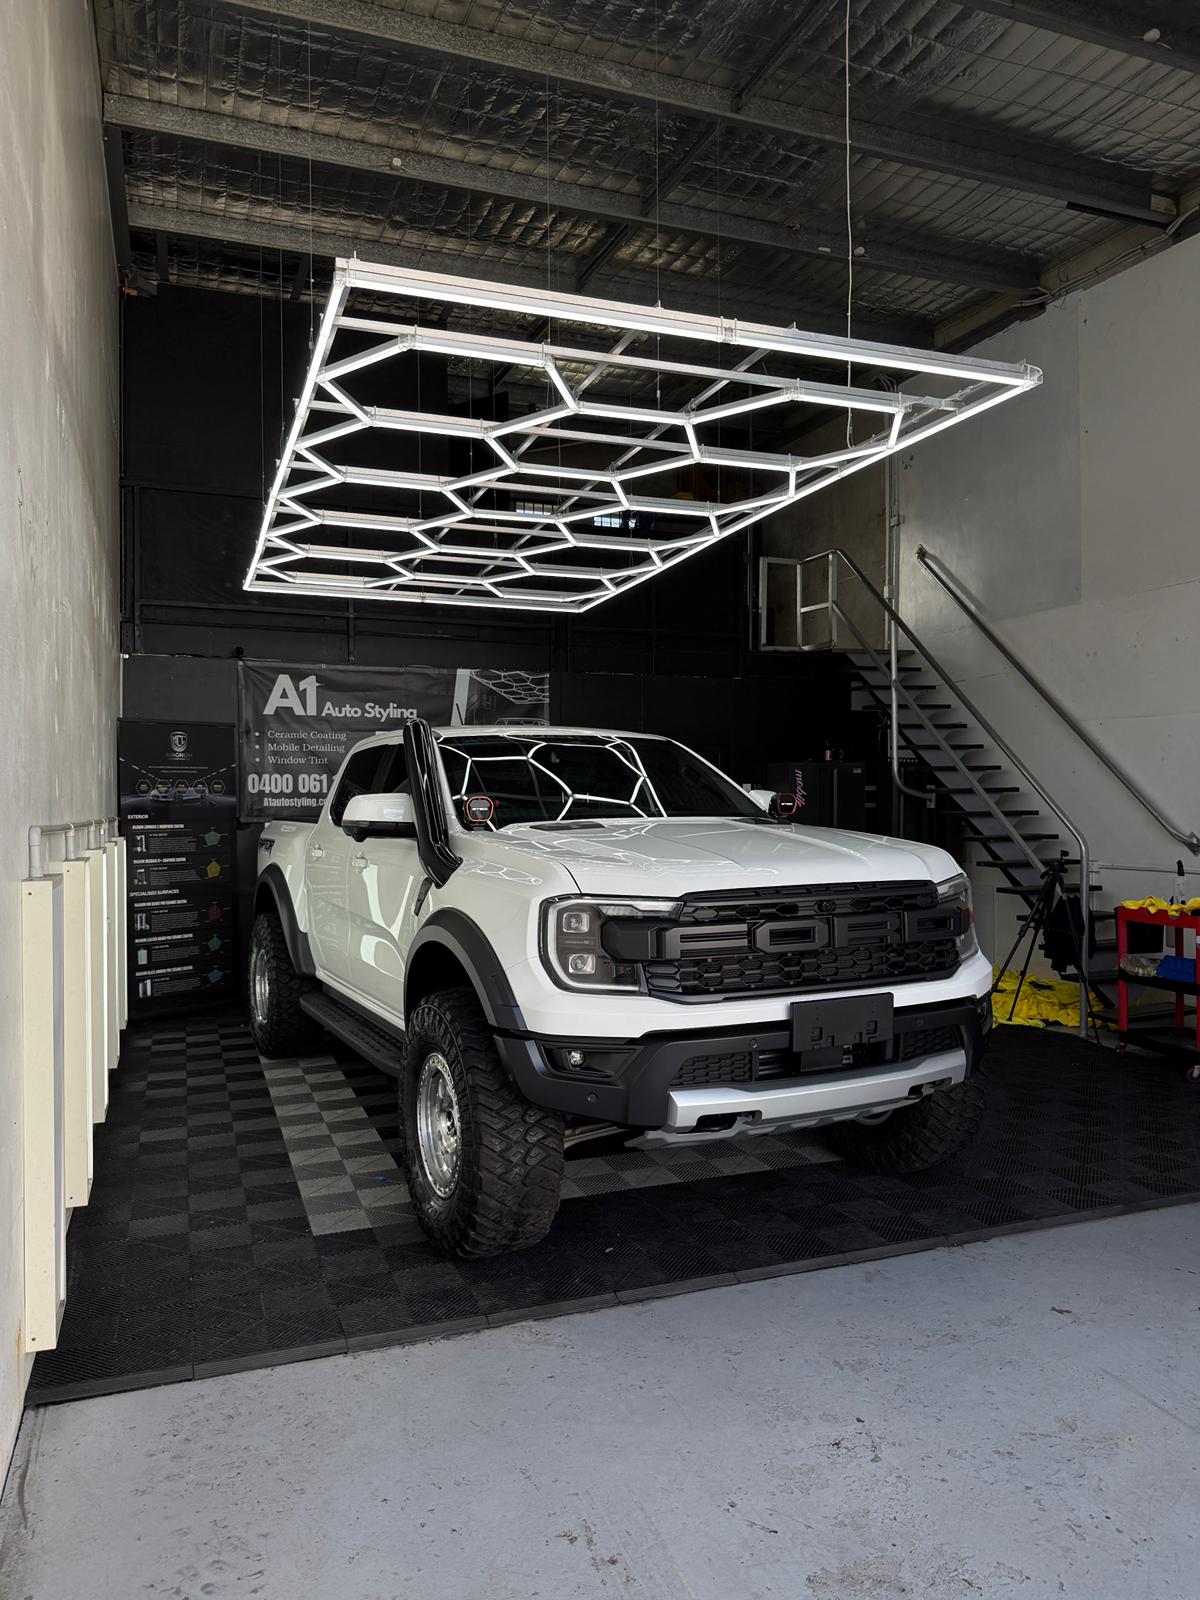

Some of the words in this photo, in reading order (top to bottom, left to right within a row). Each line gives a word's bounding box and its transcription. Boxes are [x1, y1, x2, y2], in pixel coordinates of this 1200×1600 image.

[263, 674, 321, 716] A1
[321, 701, 362, 717] Auto
[364, 702, 418, 722] Styling
[267, 730, 308, 739] Ceramic
[310, 731, 347, 741] Coating
[268, 743, 300, 751] Mobile
[302, 743, 346, 753] Detailing
[267, 756, 307, 764] Window
[308, 756, 328, 764] Tint
[248, 773, 293, 793] 0400
[298, 773, 328, 793] 061
[662, 908, 967, 960] FORD
